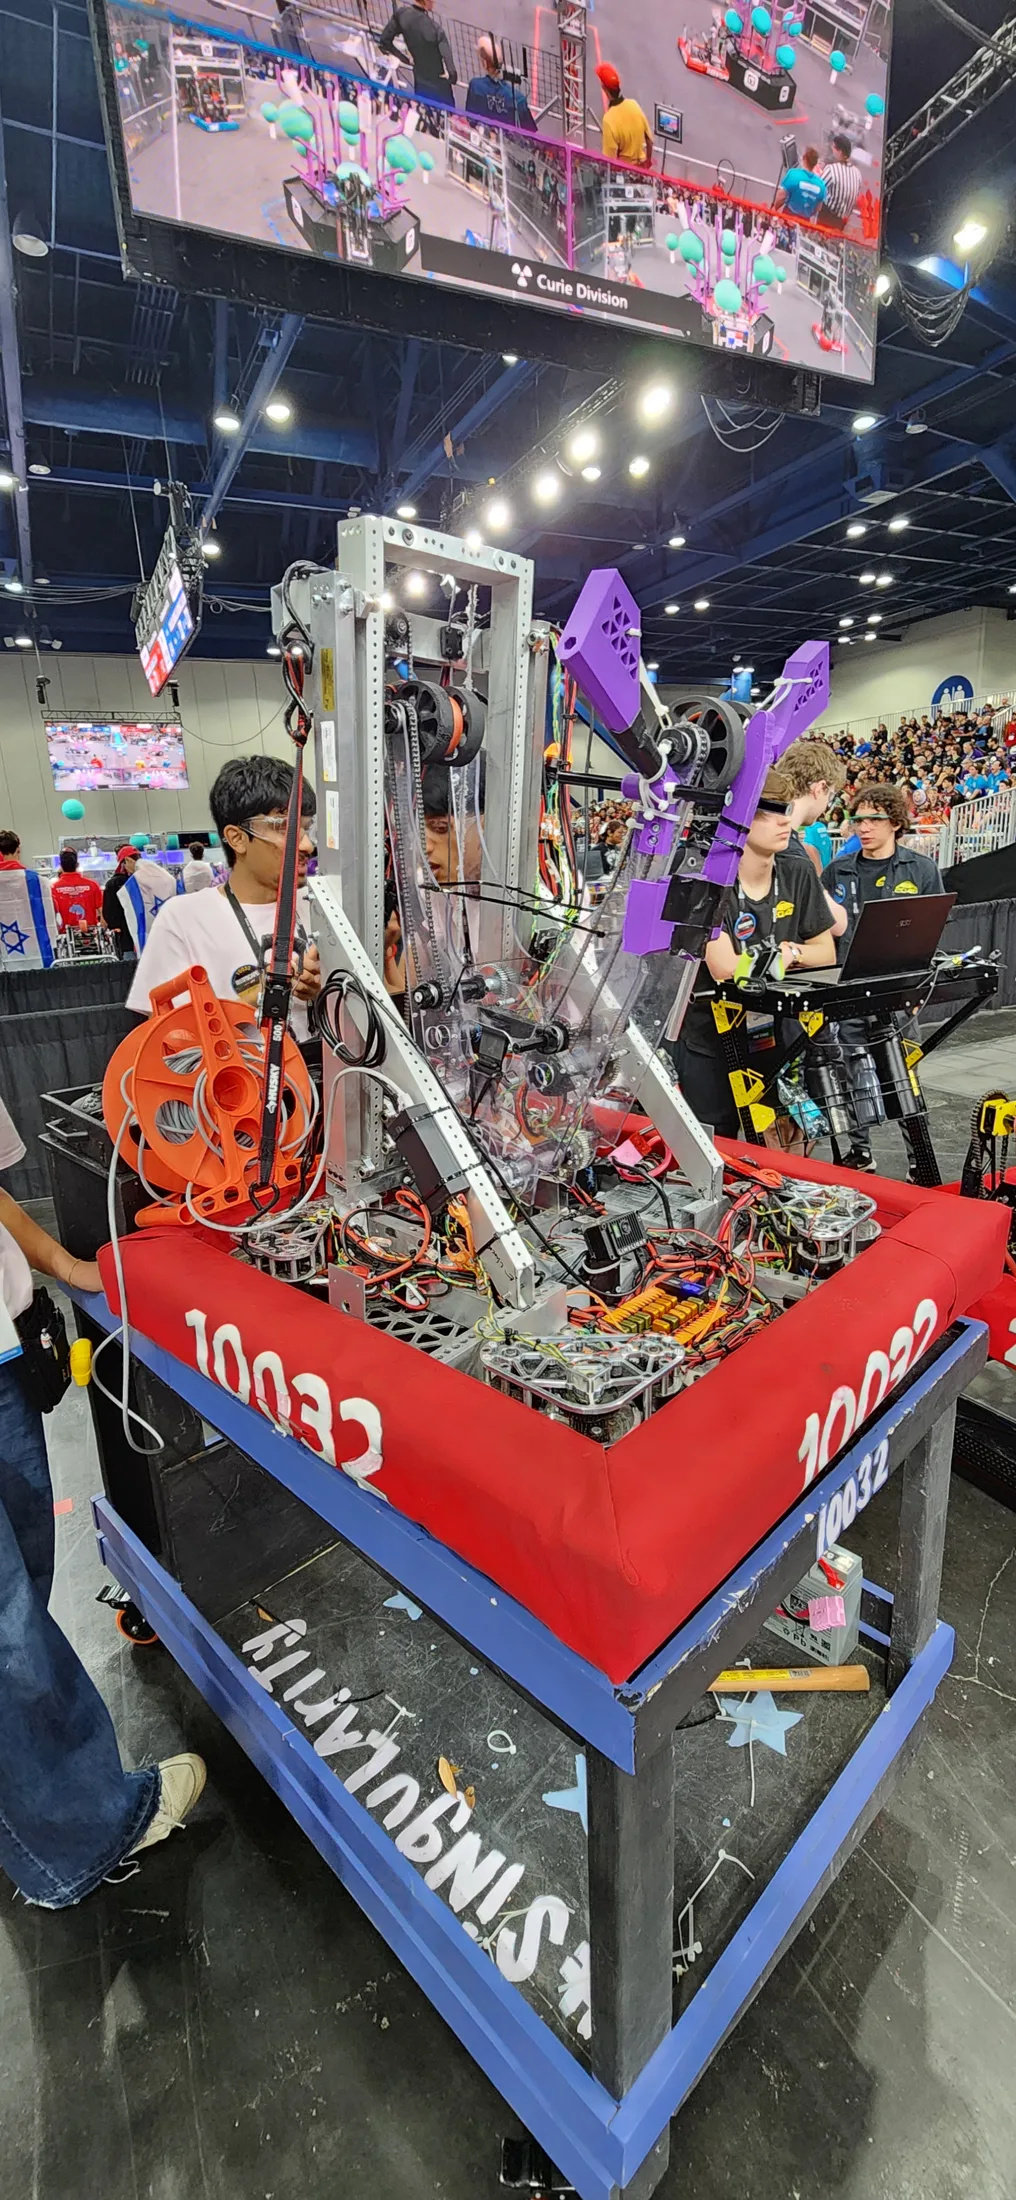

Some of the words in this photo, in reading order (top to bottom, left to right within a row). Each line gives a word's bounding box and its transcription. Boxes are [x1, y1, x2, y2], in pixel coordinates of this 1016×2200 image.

[537, 274, 573, 295] Curie
[576, 283, 628, 309] Division
[263, 1063, 280, 1101] HUSKY
[273, 1024, 283, 1041] 500
[185, 1308, 388, 1502] 10032
[798, 1299, 938, 1491] 10032
[816, 1439, 889, 1559] 10032
